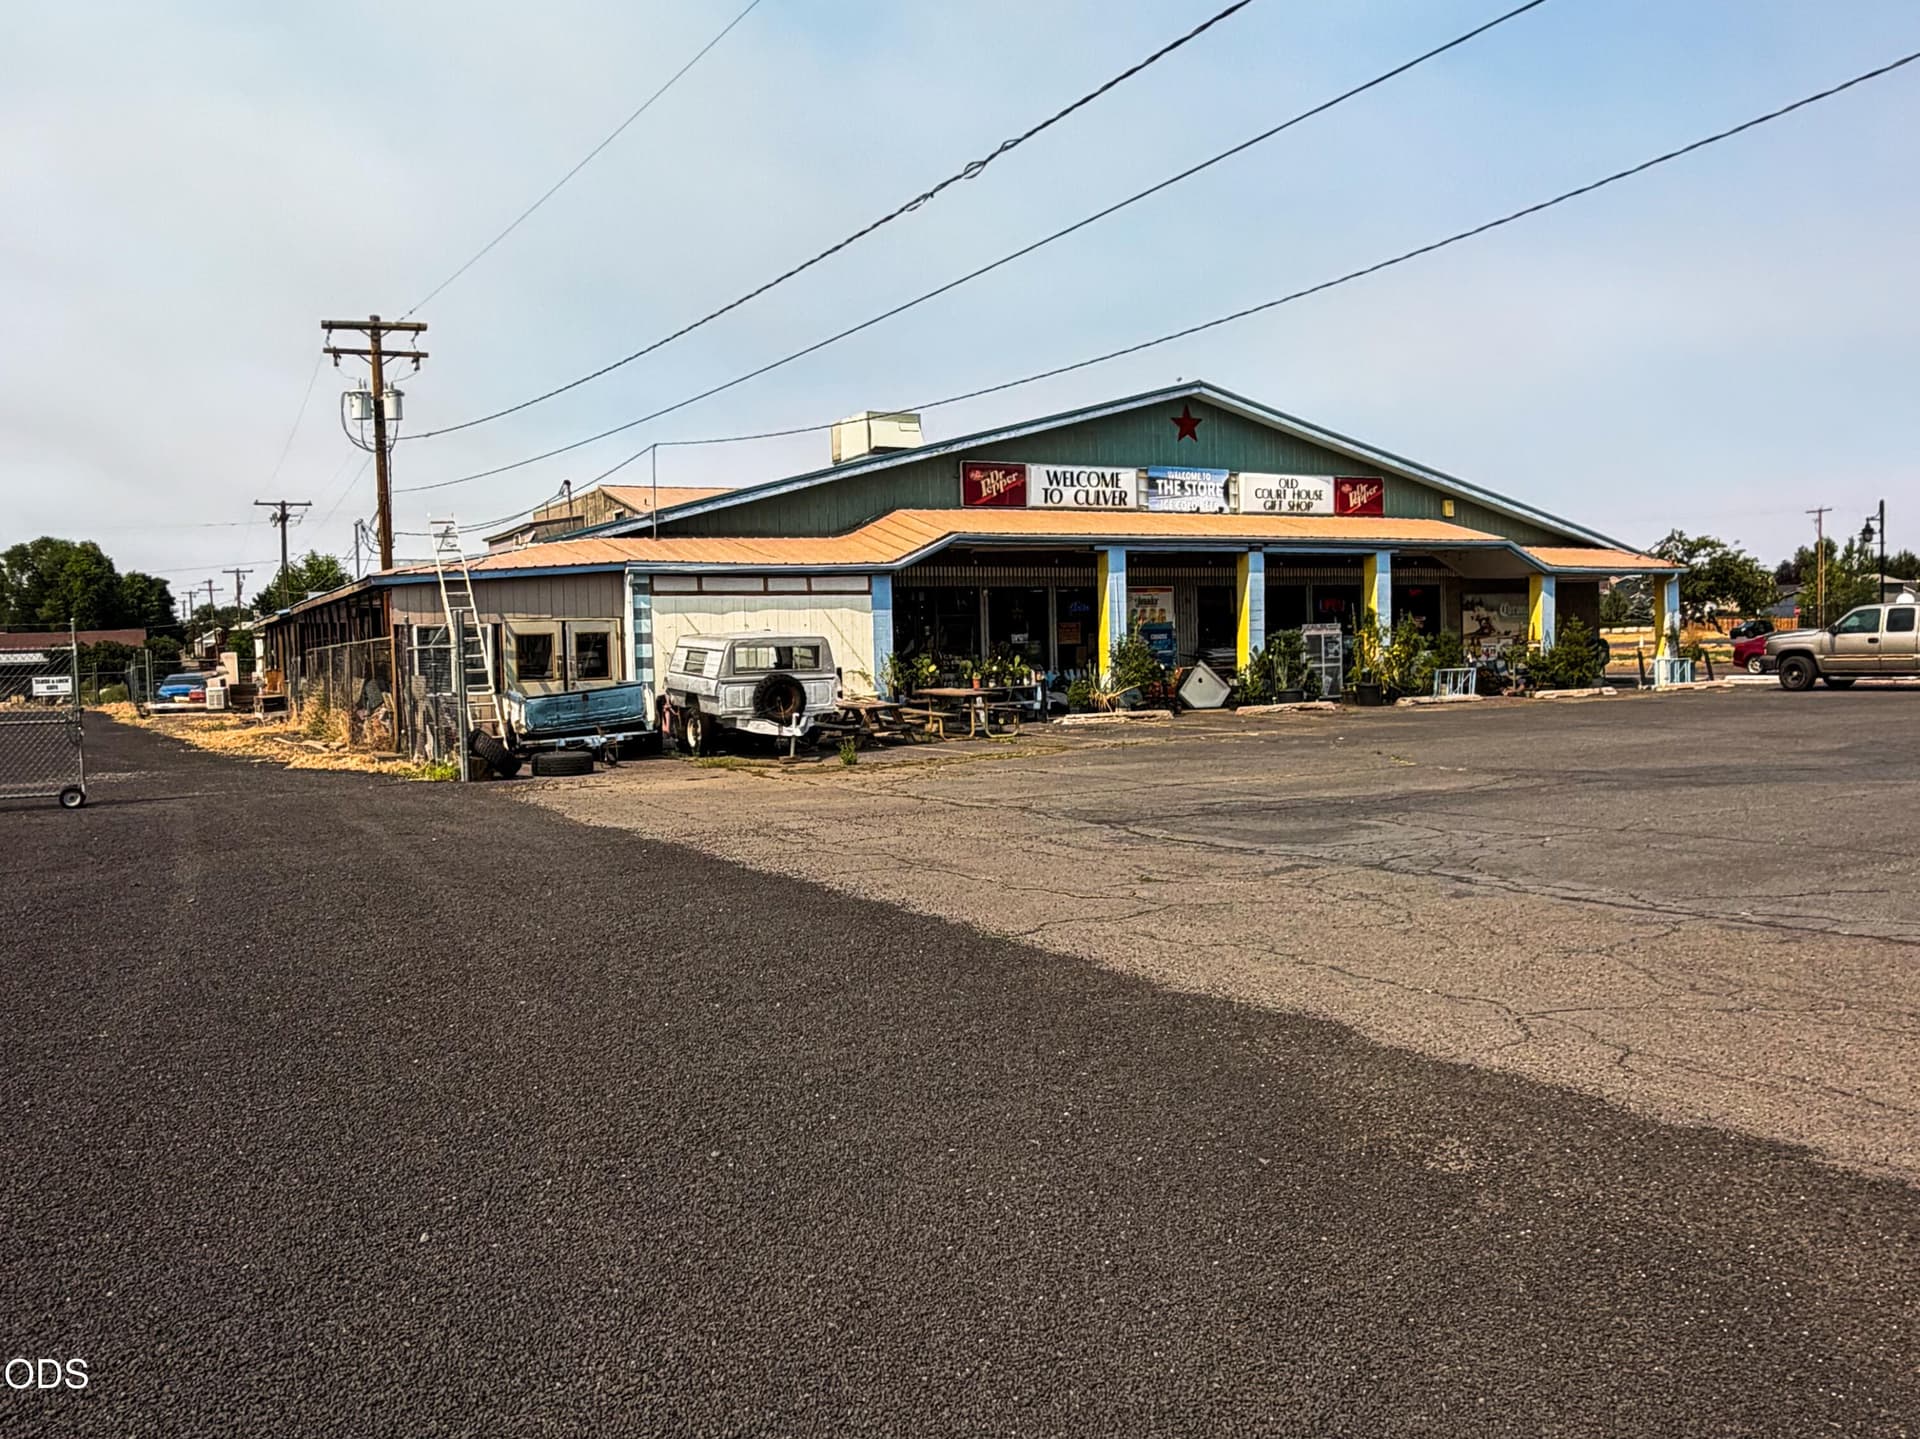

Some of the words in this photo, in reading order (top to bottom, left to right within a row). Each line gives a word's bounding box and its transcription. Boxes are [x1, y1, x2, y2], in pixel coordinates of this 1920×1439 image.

[990, 470, 1005, 484] Dr
[1046, 470, 1121, 488] WELCOME
[1168, 471, 1201, 480] WELCOME
[981, 472, 1018, 497] Pepper
[1156, 480, 1181, 495] THE
[1184, 481, 1224, 497] STORE
[1278, 478, 1299, 489] OLD
[1042, 488, 1063, 504] TO
[1074, 489, 1128, 506] CULVER
[1255, 488, 1286, 500] COURT
[1292, 489, 1324, 501] HOUSE
[1263, 500, 1282, 511] GIFT
[1288, 500, 1314, 511] SHOP
